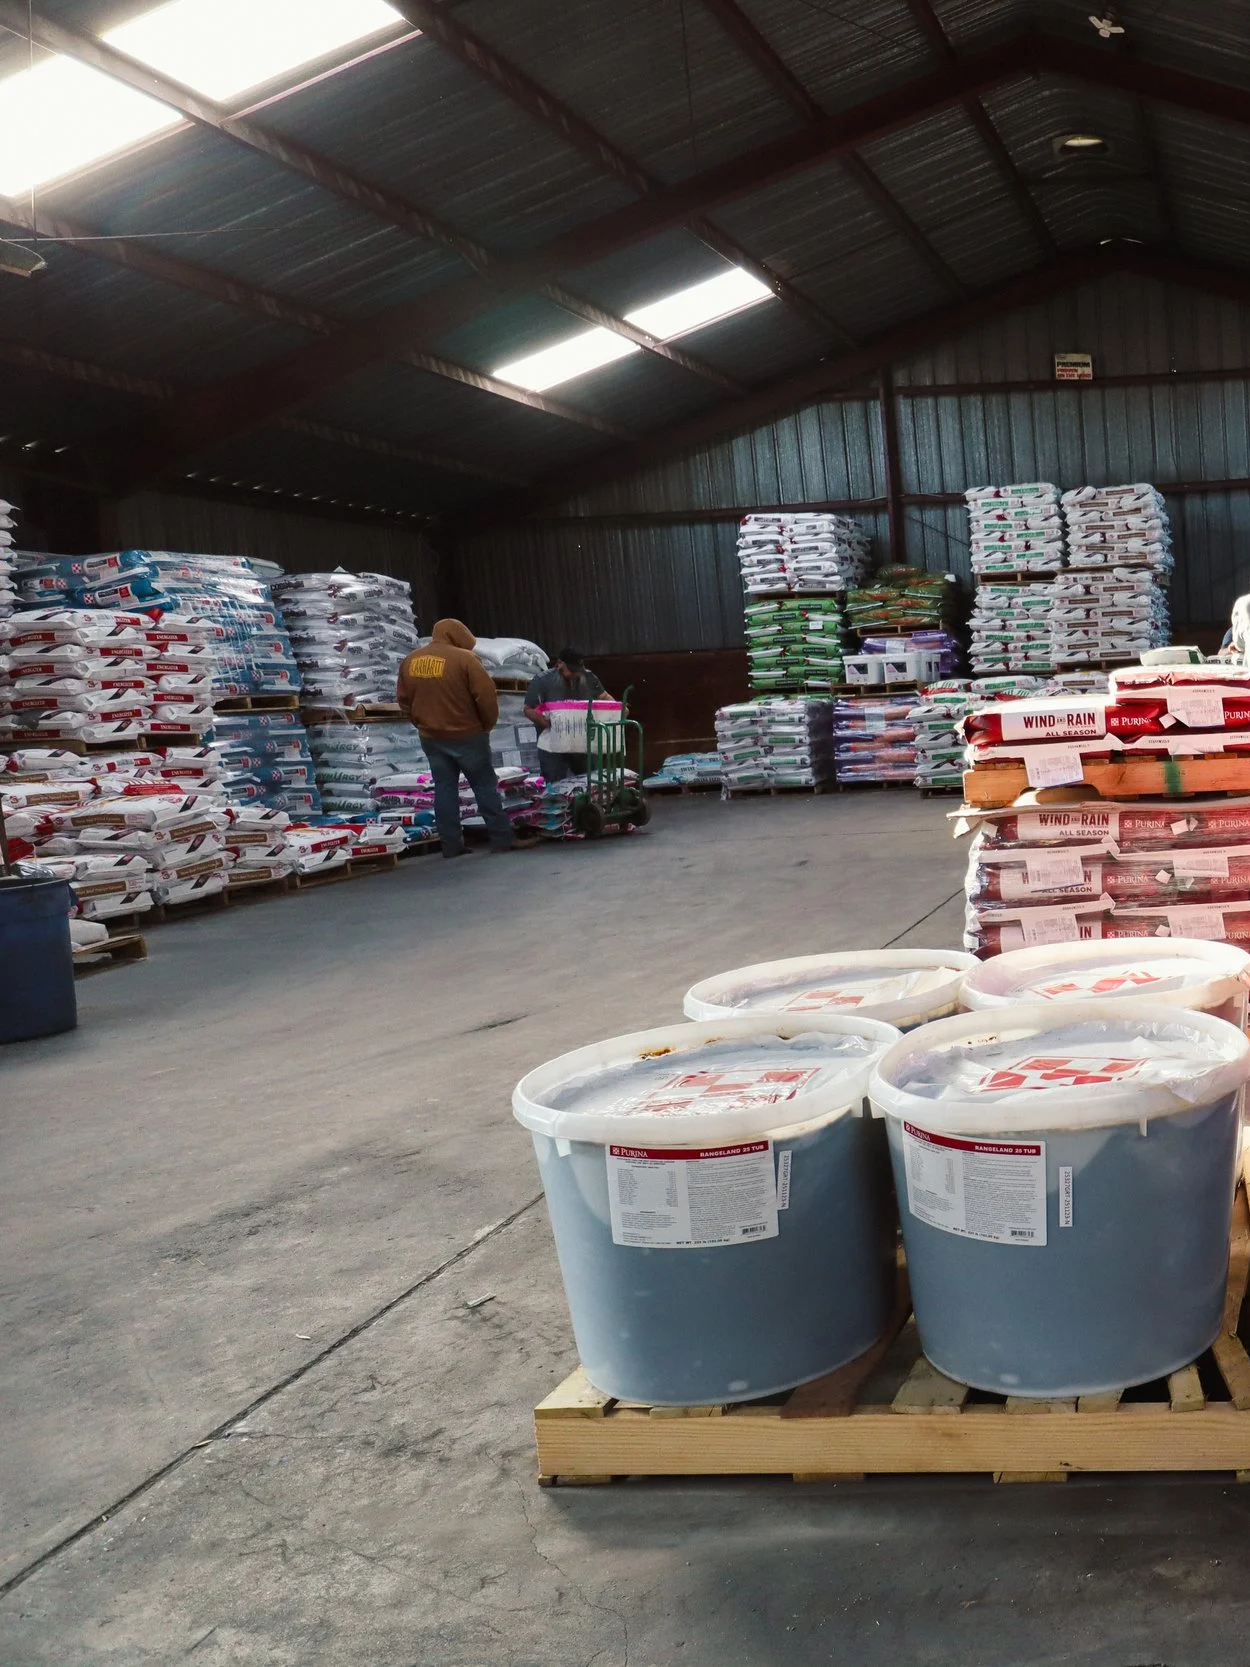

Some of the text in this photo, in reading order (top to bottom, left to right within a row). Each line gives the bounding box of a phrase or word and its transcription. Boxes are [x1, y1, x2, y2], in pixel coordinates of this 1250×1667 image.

[1023, 715, 1055, 729] WIND
[1067, 712, 1095, 727] RAIN
[1045, 729, 1097, 738] ALL SEASON
[1039, 813, 1071, 827] WIND
[1081, 813, 1110, 827] RAIN
[1135, 819, 1166, 829] PURINA
[1219, 819, 1250, 830] PURINA
[1076, 829, 1110, 837] SEASON
[1118, 875, 1148, 885] PURINA
[1060, 886, 1093, 895] SEASON
[1080, 926, 1093, 939] IN
[1118, 930, 1149, 938] PURINA
[910, 1126, 931, 1142] PURINA
[620, 1147, 649, 1158] PURINA
[700, 1148, 741, 1158] RANGELAND
[974, 1145, 1013, 1154] RANGELAND
